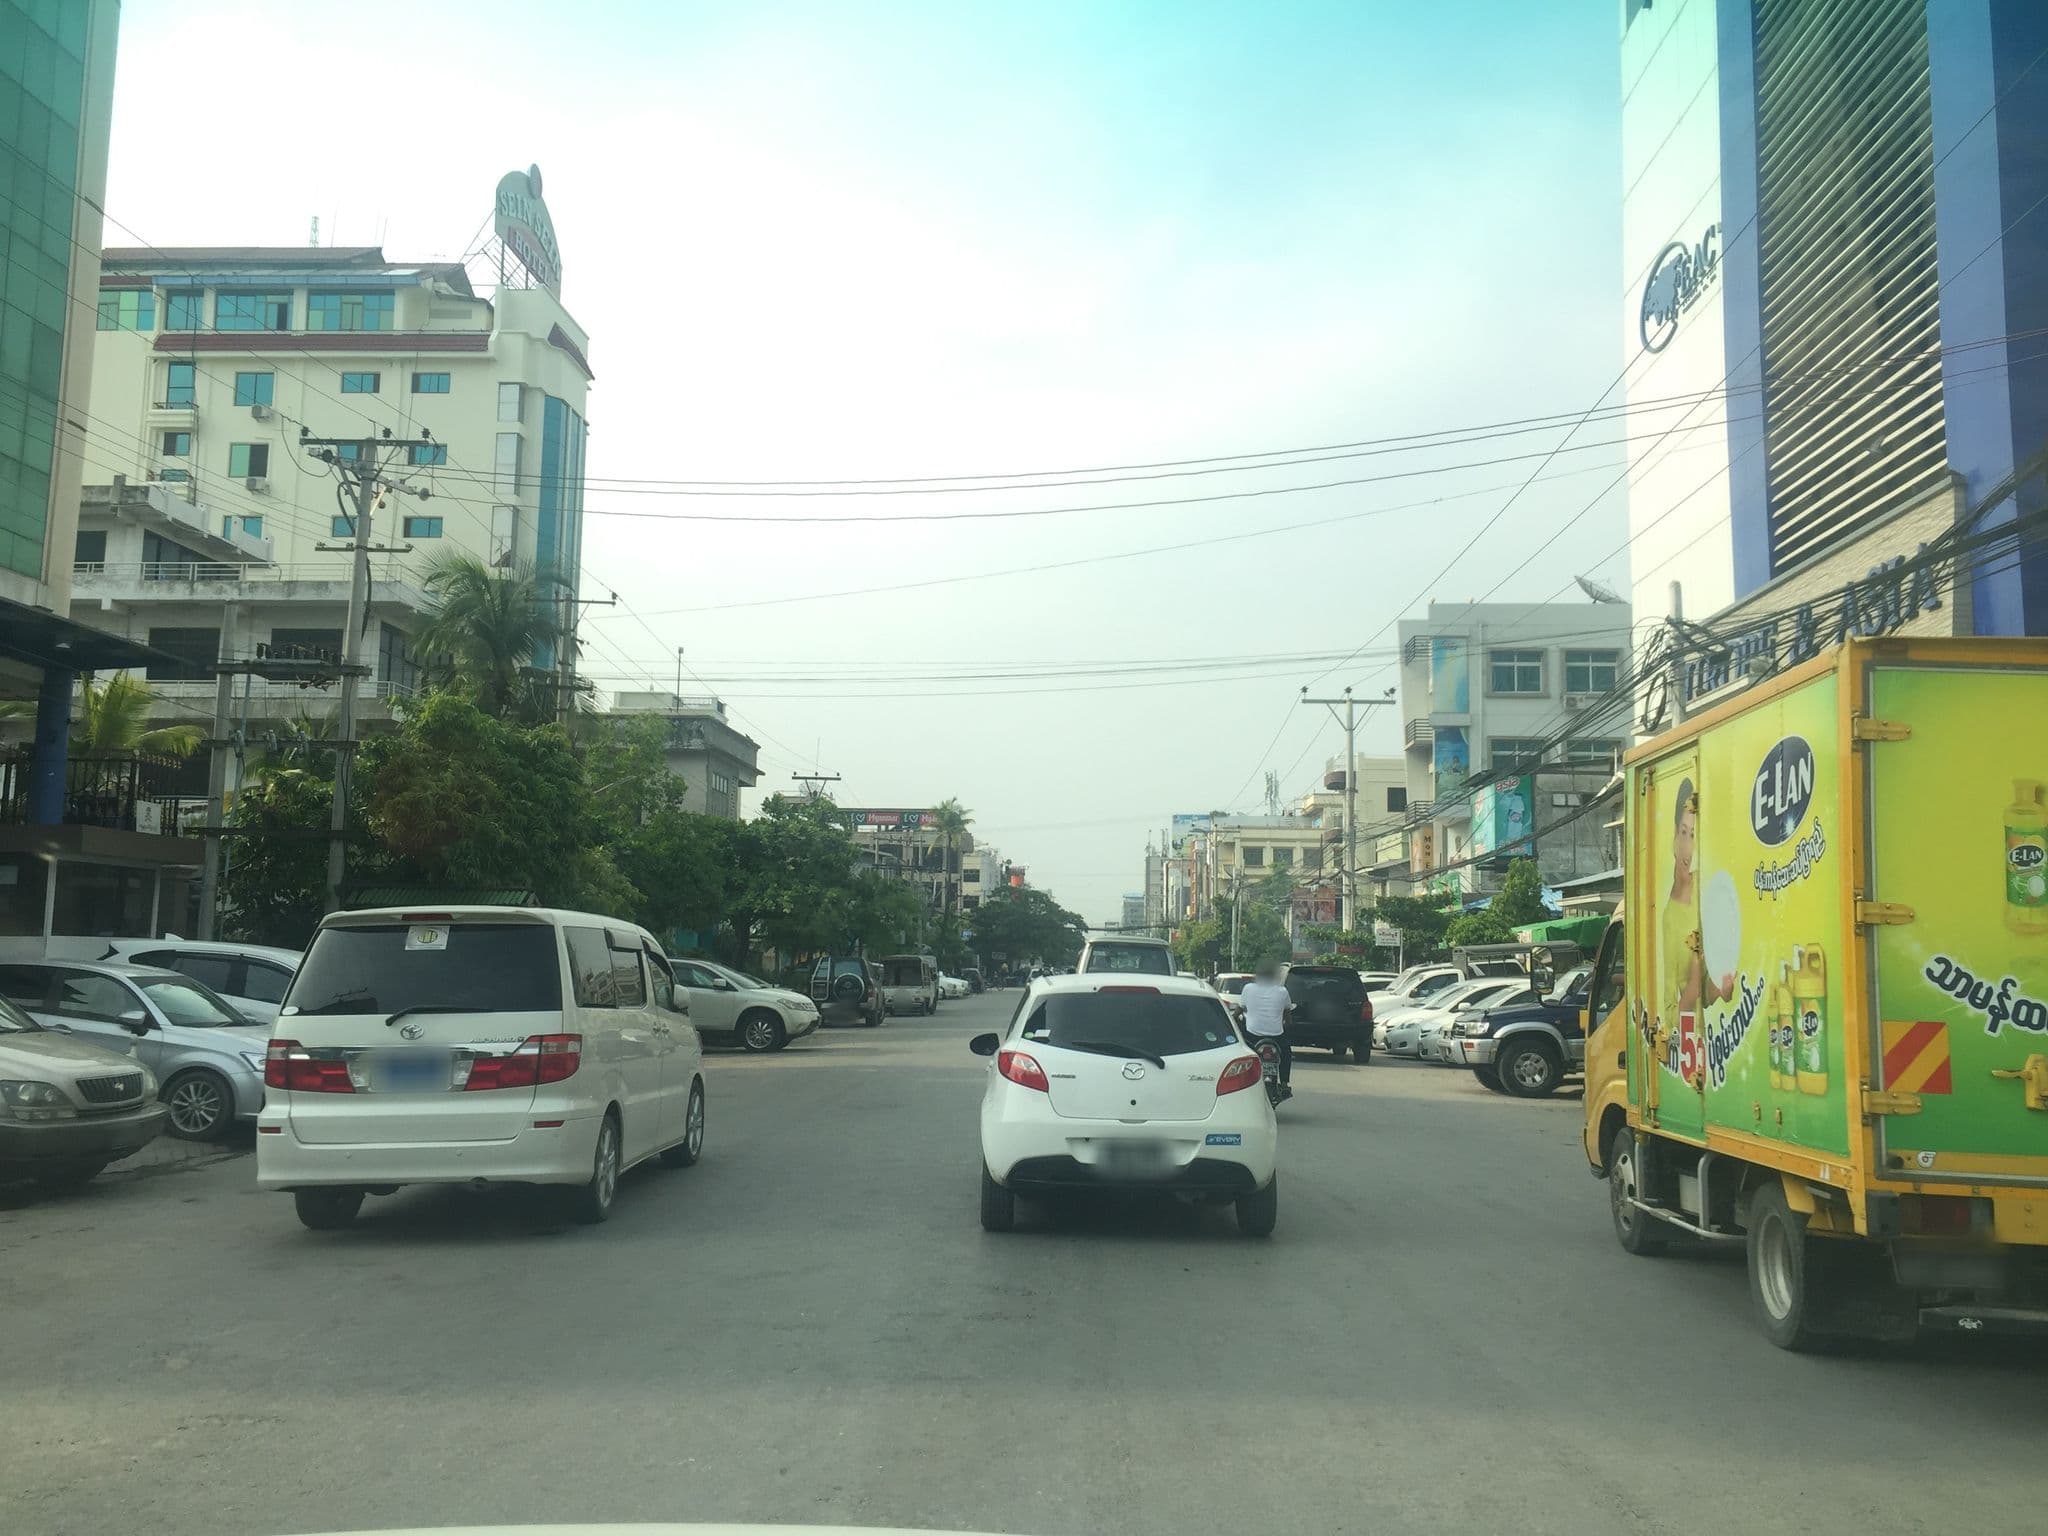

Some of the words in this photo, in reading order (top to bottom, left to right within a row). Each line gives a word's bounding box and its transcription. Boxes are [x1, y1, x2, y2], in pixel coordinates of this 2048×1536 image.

[514, 231, 551, 285] HOTEL
[1755, 751, 1811, 831] E-LAN
[2012, 849, 2042, 863] E-LAN
[1925, 957, 2048, 1034] သာမန်ထ
